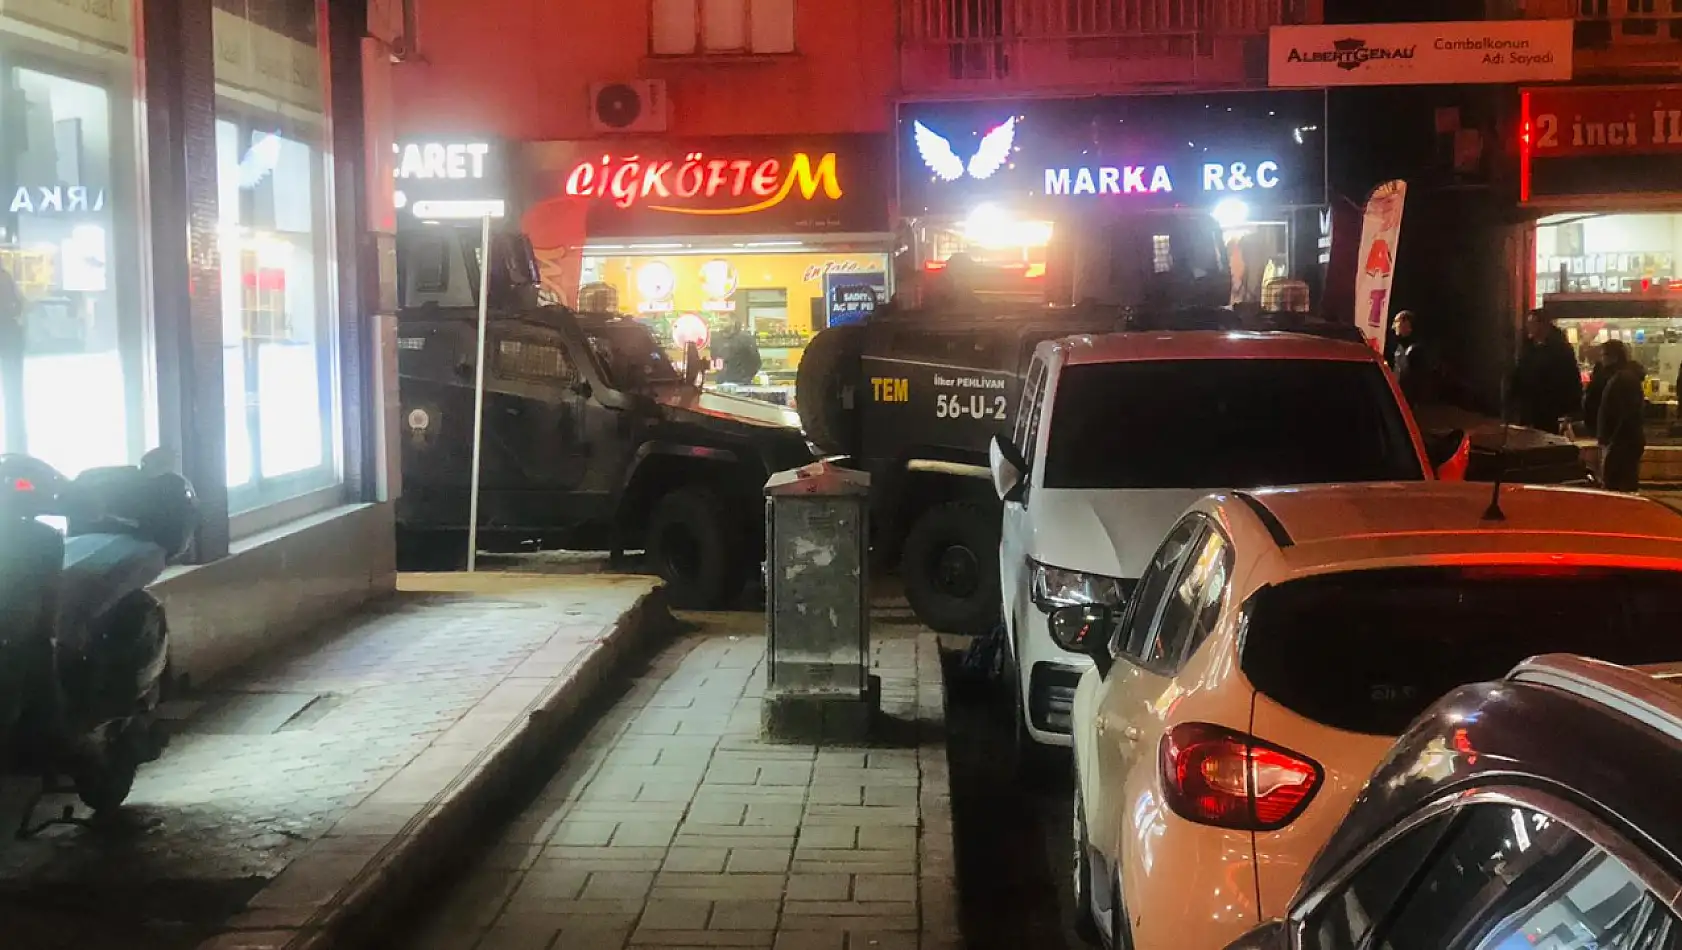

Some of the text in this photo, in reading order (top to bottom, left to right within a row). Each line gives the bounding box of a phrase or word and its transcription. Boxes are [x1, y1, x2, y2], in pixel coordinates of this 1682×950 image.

[1536, 113, 1558, 148] 2
[1572, 114, 1637, 146] inci
[1045, 161, 1280, 195] MARKA R&C
[871, 377, 909, 402] TEM
[957, 376, 1005, 389] PEHLİVAN
[936, 394, 1007, 419] 56-U-2
